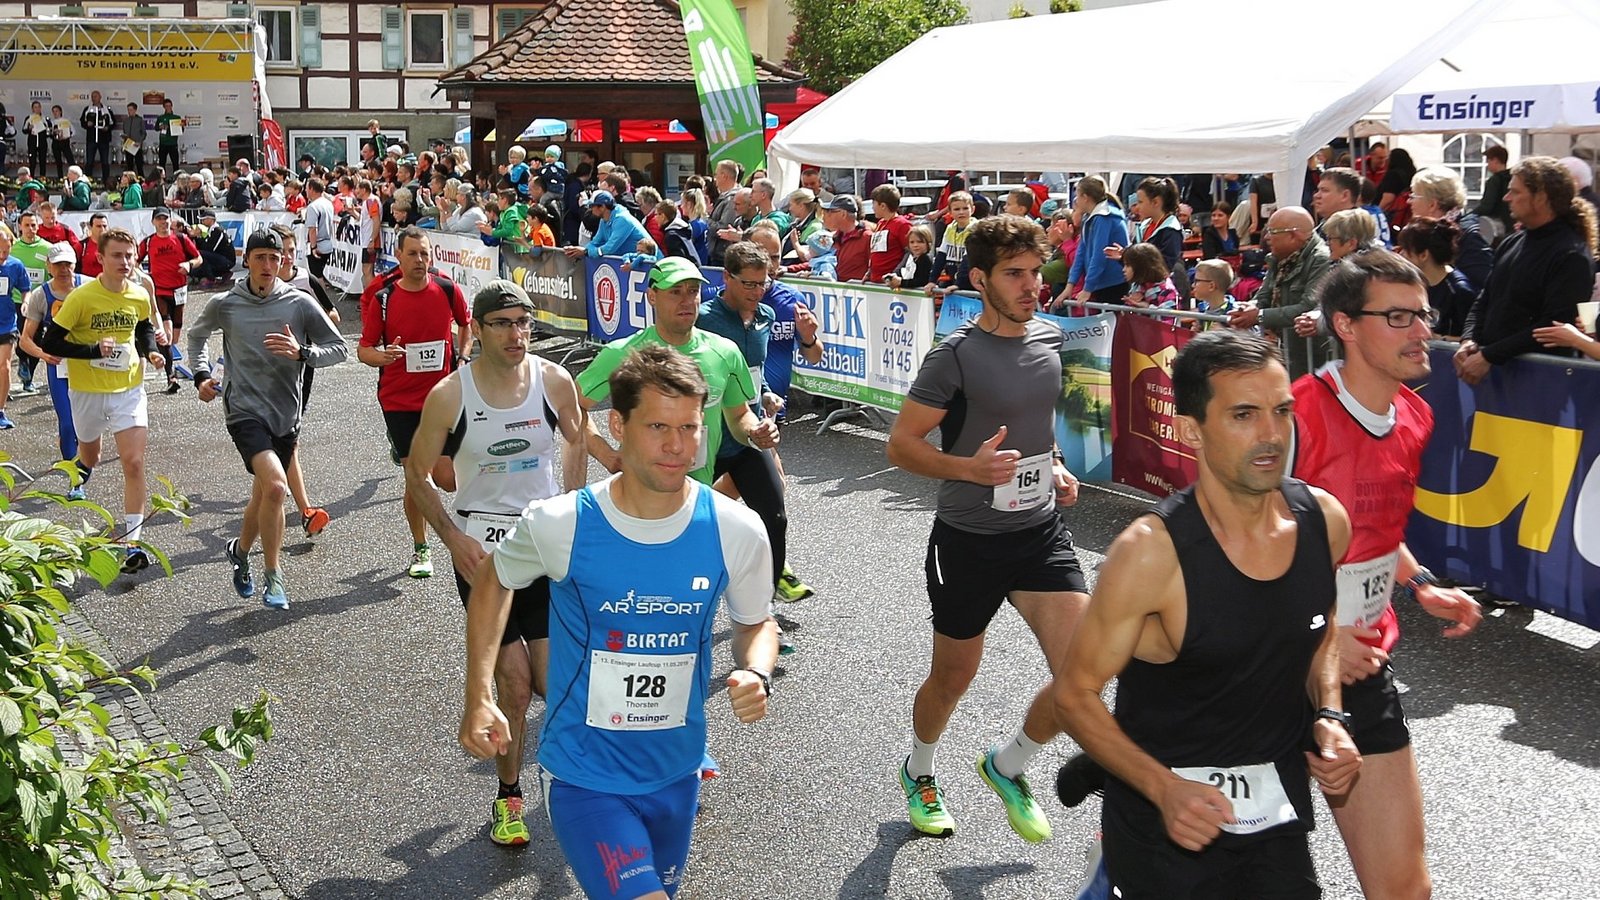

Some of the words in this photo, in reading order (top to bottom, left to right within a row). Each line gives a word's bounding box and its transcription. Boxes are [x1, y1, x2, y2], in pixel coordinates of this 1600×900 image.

[77, 60, 96, 69] TSV
[100, 60, 147, 70] Ensingen
[151, 61, 176, 69] 1911
[1417, 94, 1536, 126] Ensinger
[882, 326, 914, 347] 07042
[418, 349, 436, 360] 132
[1017, 468, 1041, 489] 164
[485, 526, 509, 543] 20
[1361, 571, 1390, 600] 123
[635, 602, 704, 615] SPORT
[626, 632, 690, 649] BIRTAT
[610, 658, 637, 667] Ensinger
[638, 660, 662, 668] Laufcup
[623, 674, 667, 698] 128
[627, 713, 670, 724] Ensinger
[1208, 772, 1251, 799] 211
